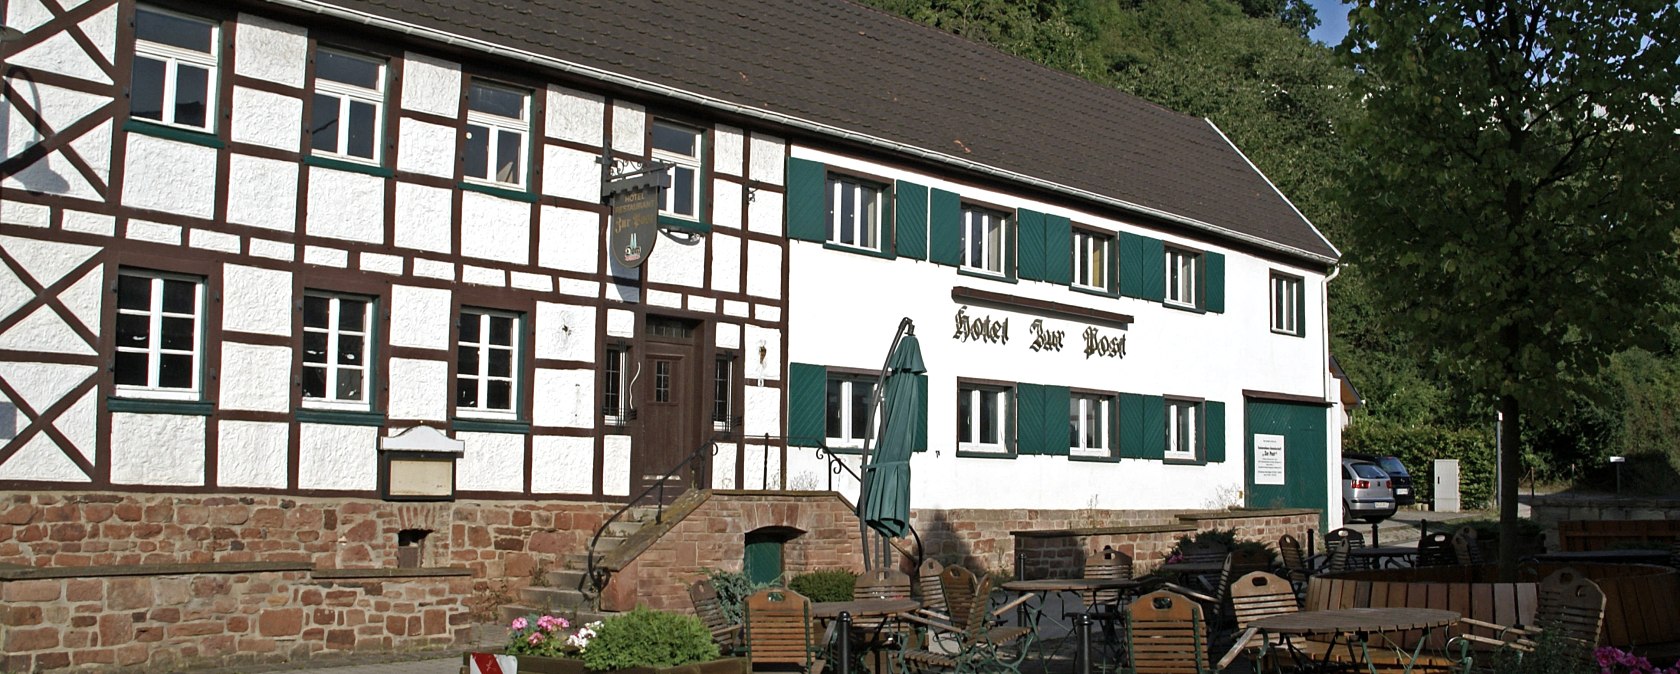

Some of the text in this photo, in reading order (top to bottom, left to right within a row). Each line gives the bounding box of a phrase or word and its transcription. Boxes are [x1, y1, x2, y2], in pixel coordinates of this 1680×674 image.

[624, 192, 645, 202] HOTEL
[952, 305, 1127, 360] Hotel Zur Post
